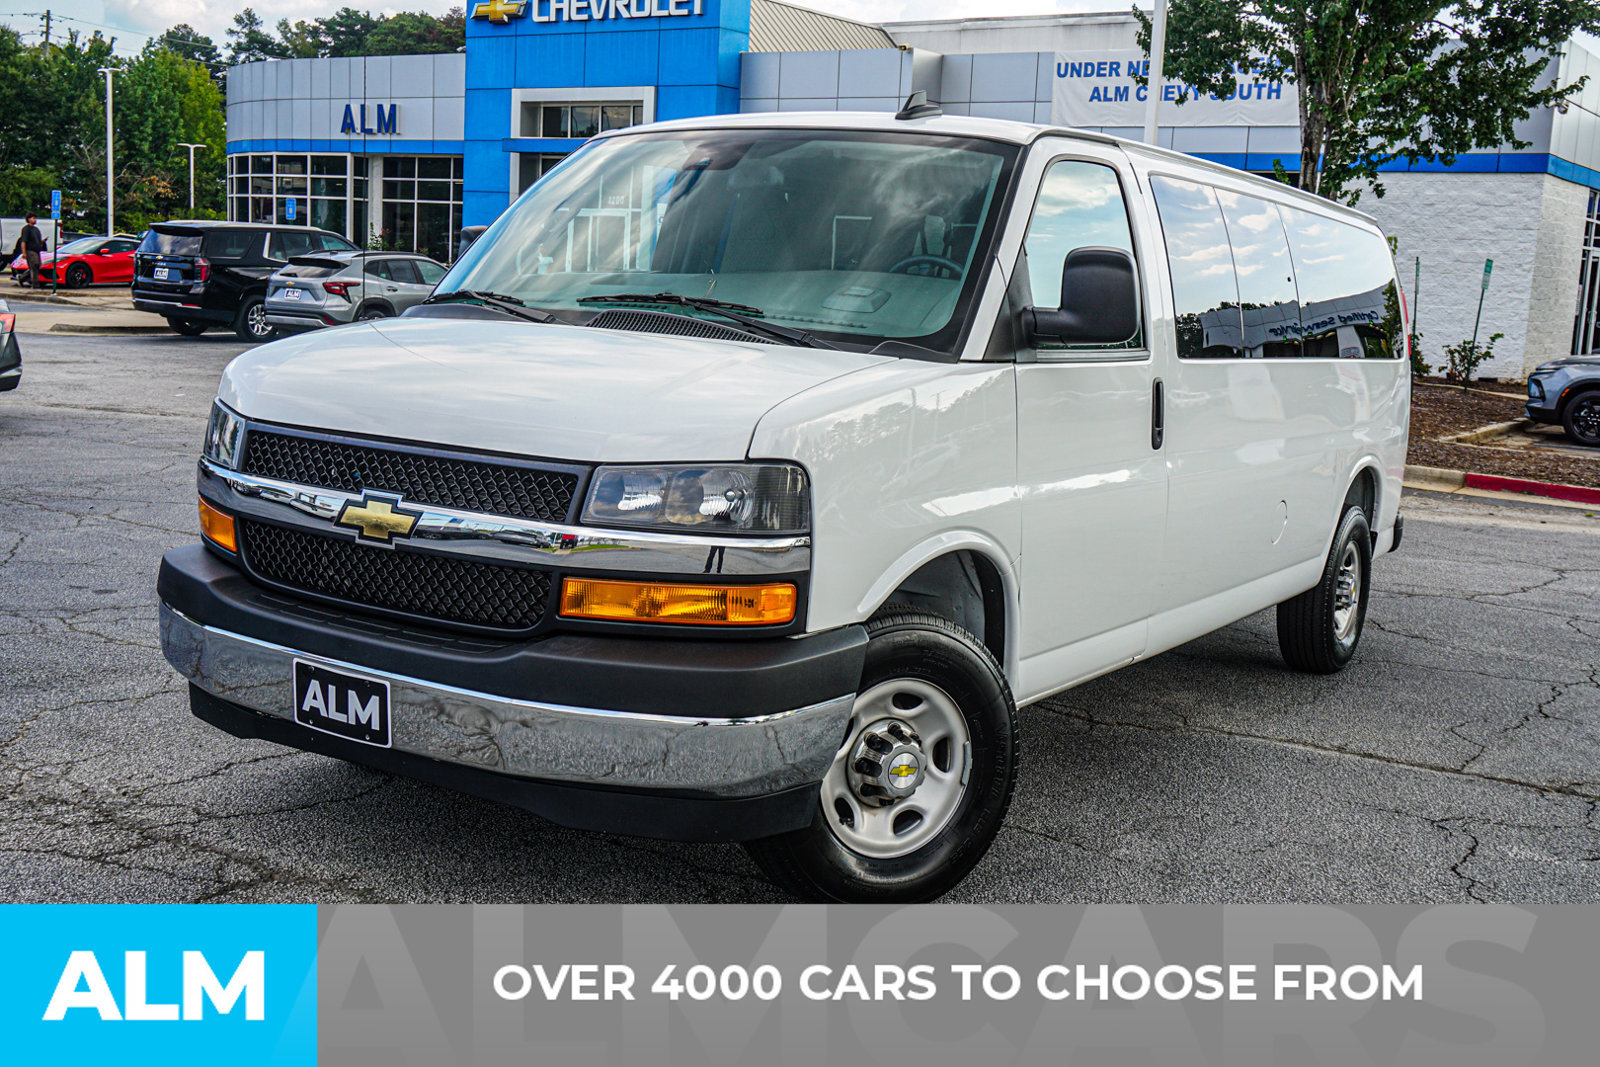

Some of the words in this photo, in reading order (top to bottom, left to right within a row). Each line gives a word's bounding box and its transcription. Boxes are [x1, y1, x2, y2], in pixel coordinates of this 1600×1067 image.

[1056, 61, 1121, 78] UNDER
[1088, 85, 1129, 102] ALM
[1135, 84, 1199, 102] CEVY
[340, 103, 398, 134] ALM
[301, 678, 380, 731] ALM
